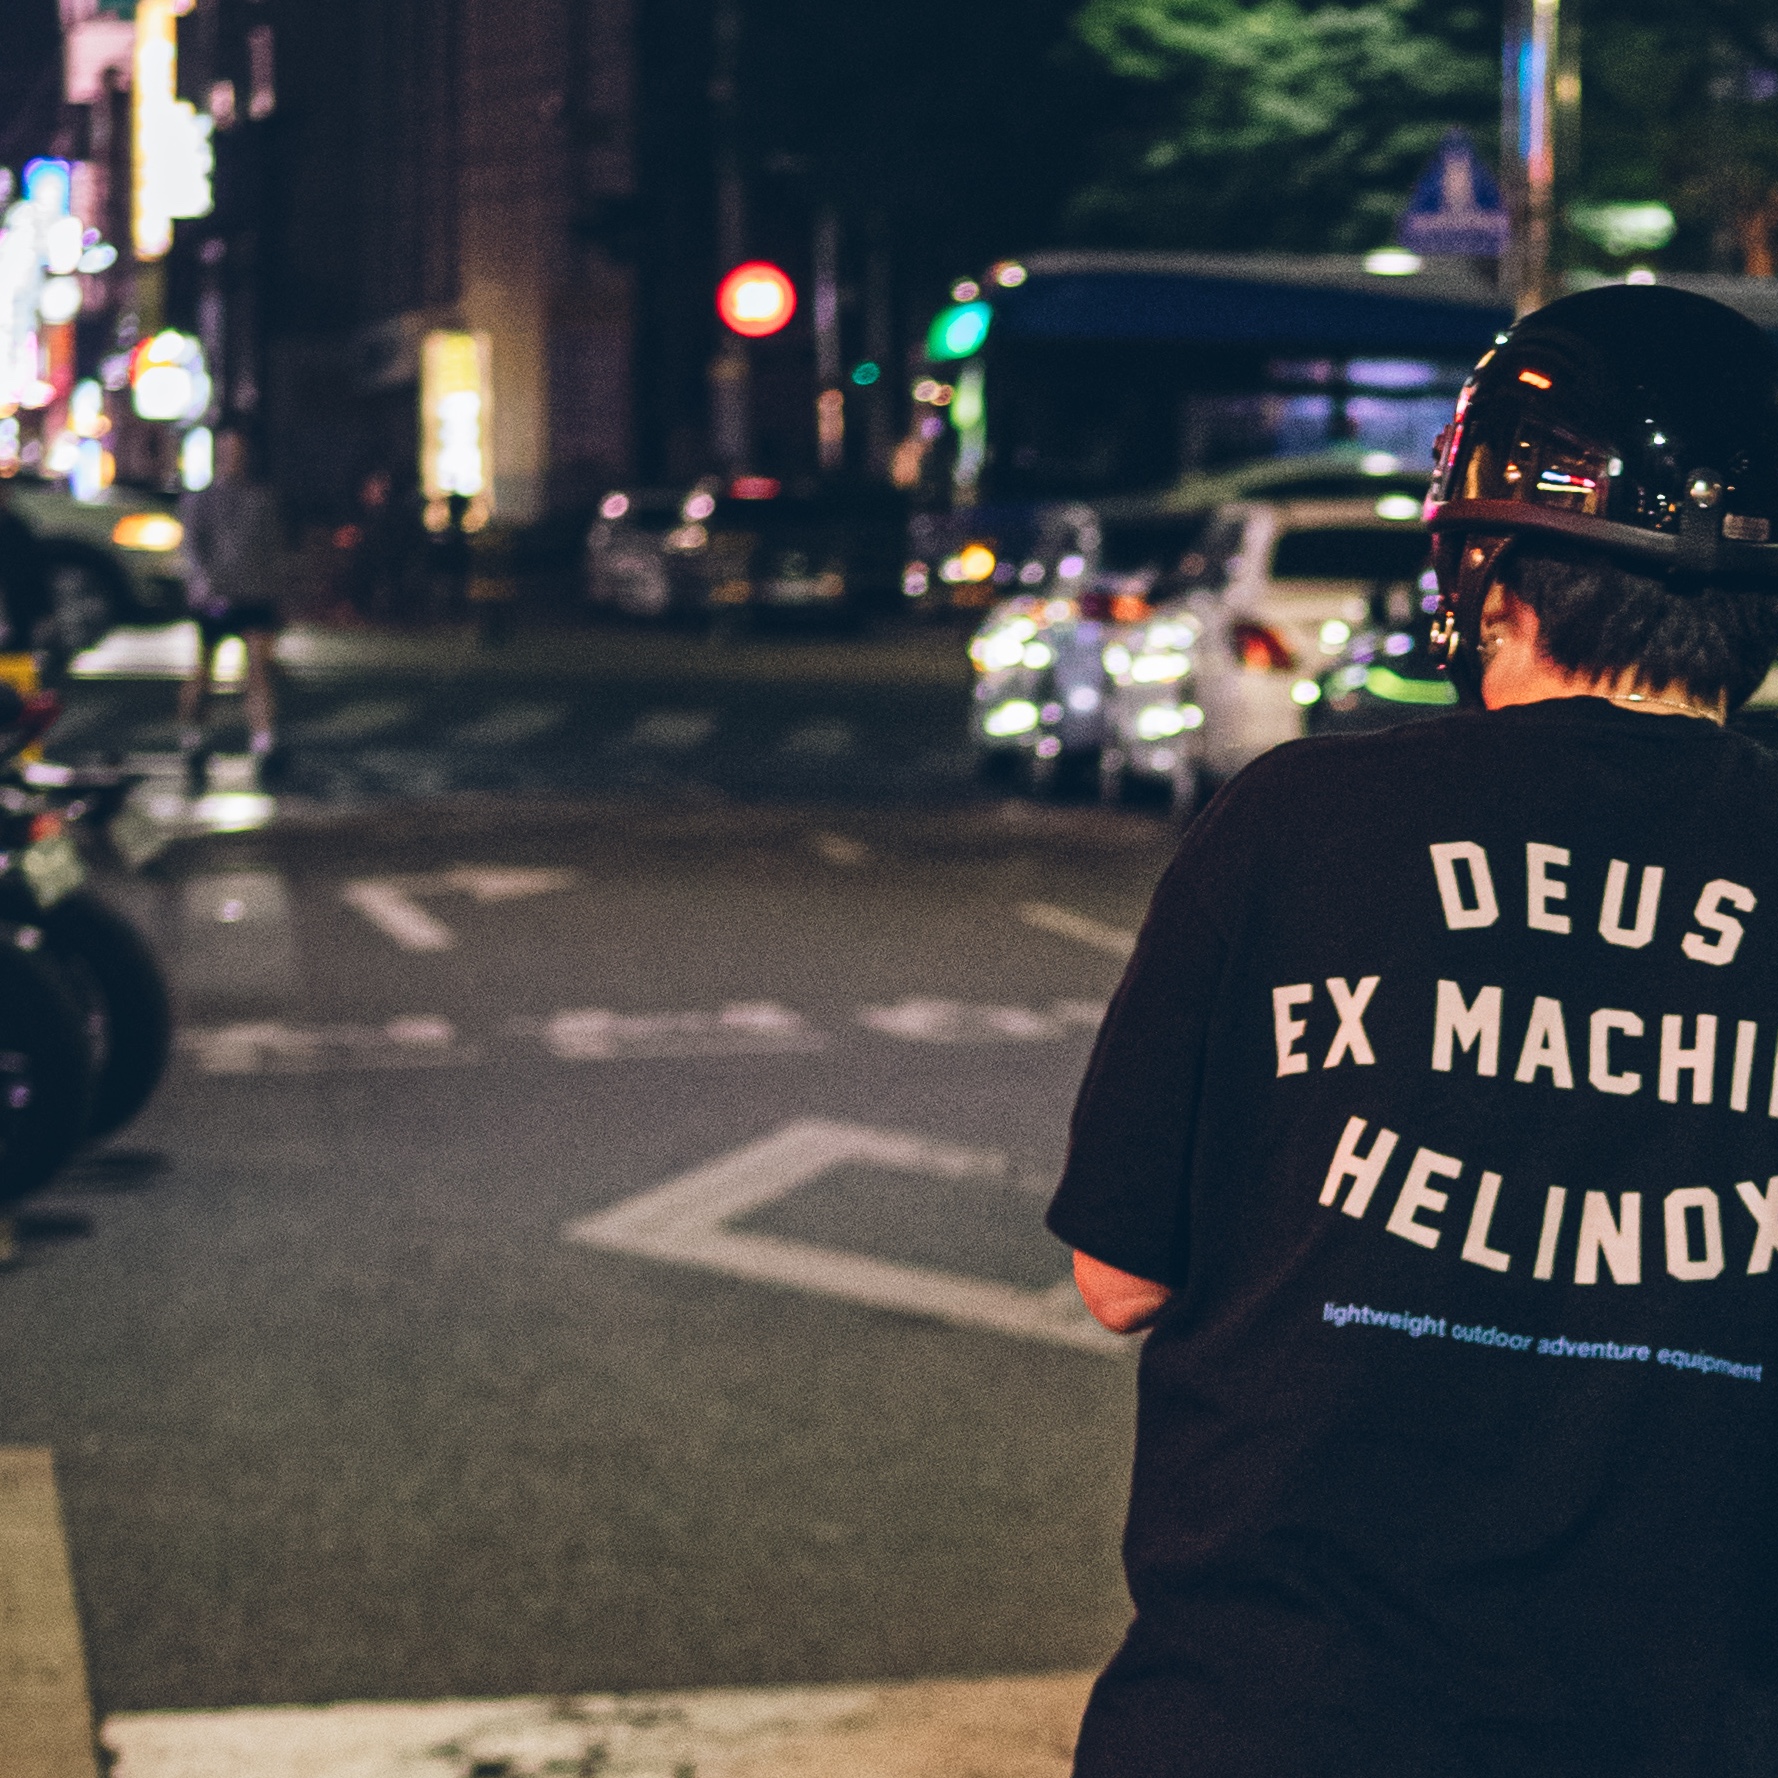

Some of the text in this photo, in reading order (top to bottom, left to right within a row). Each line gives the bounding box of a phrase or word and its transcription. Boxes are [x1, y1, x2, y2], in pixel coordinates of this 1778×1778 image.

[1429, 840, 1757, 966] DEUS
[1272, 974, 1381, 1078] EX
[1322, 1302, 1763, 1382] lightweight outdoor adventure equipment
